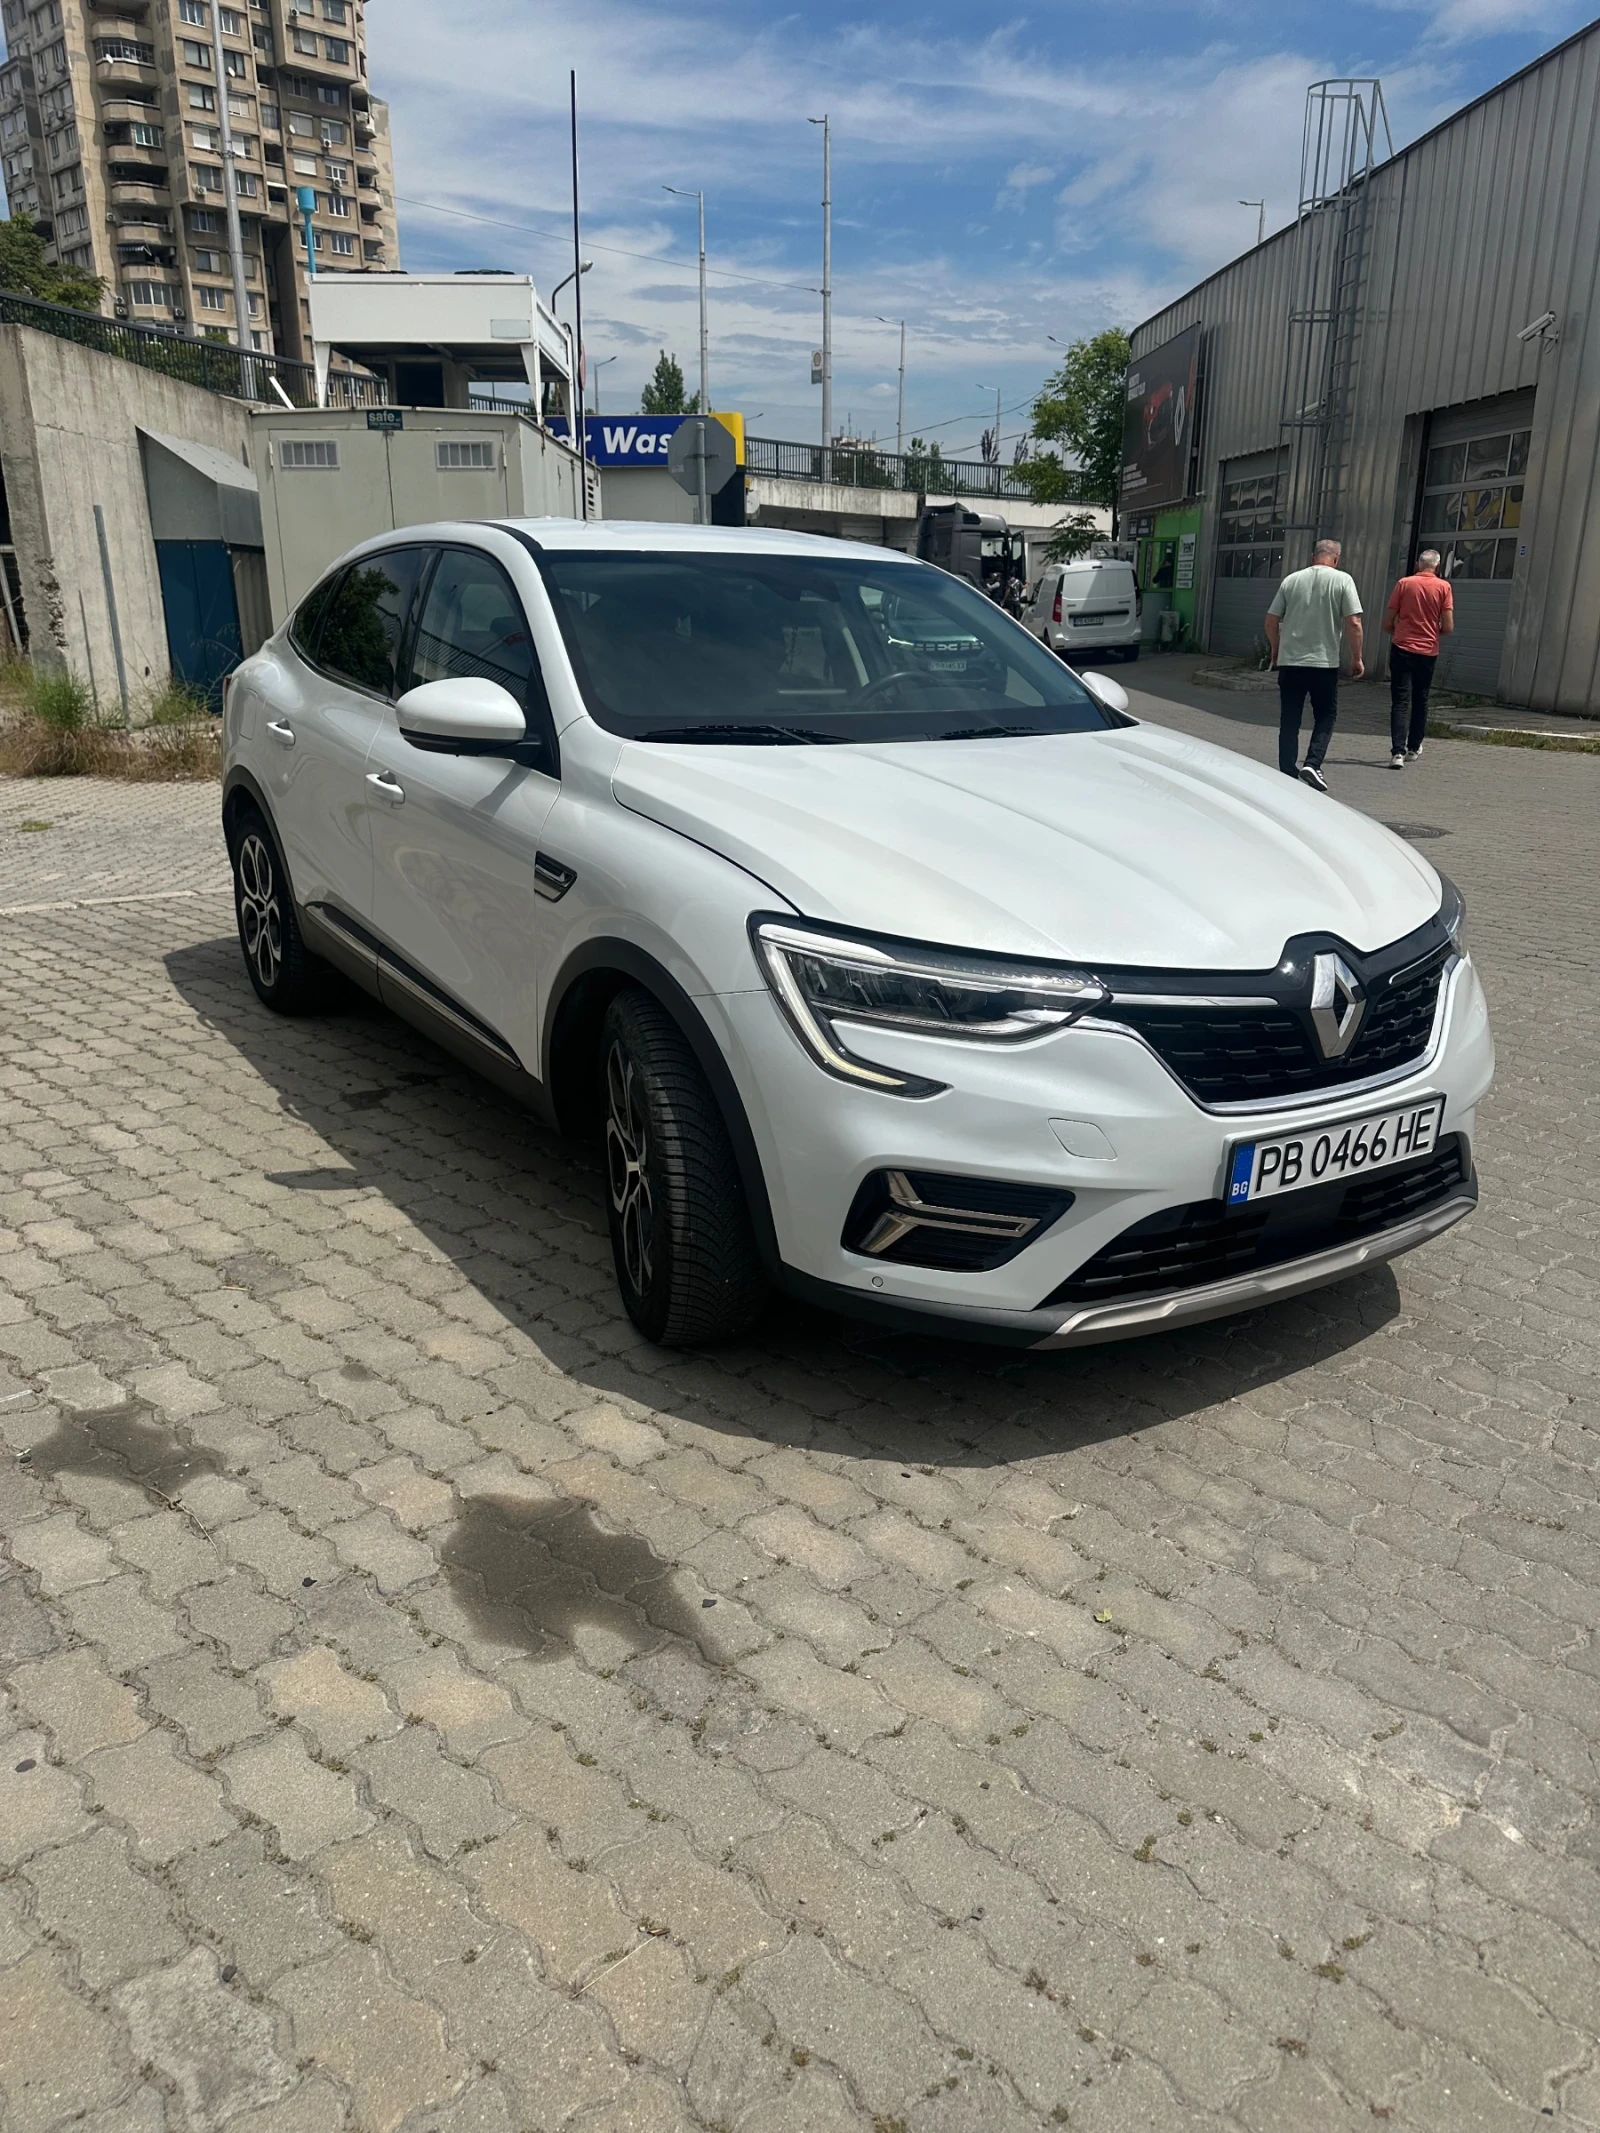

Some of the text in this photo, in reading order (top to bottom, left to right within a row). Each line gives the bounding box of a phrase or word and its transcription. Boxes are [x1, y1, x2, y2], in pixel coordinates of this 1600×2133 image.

[368, 410, 396, 422] safe
[602, 425, 682, 454] Was
[1255, 1106, 1435, 1192] PB 0466 HE
[1231, 1181, 1248, 1197] BG
